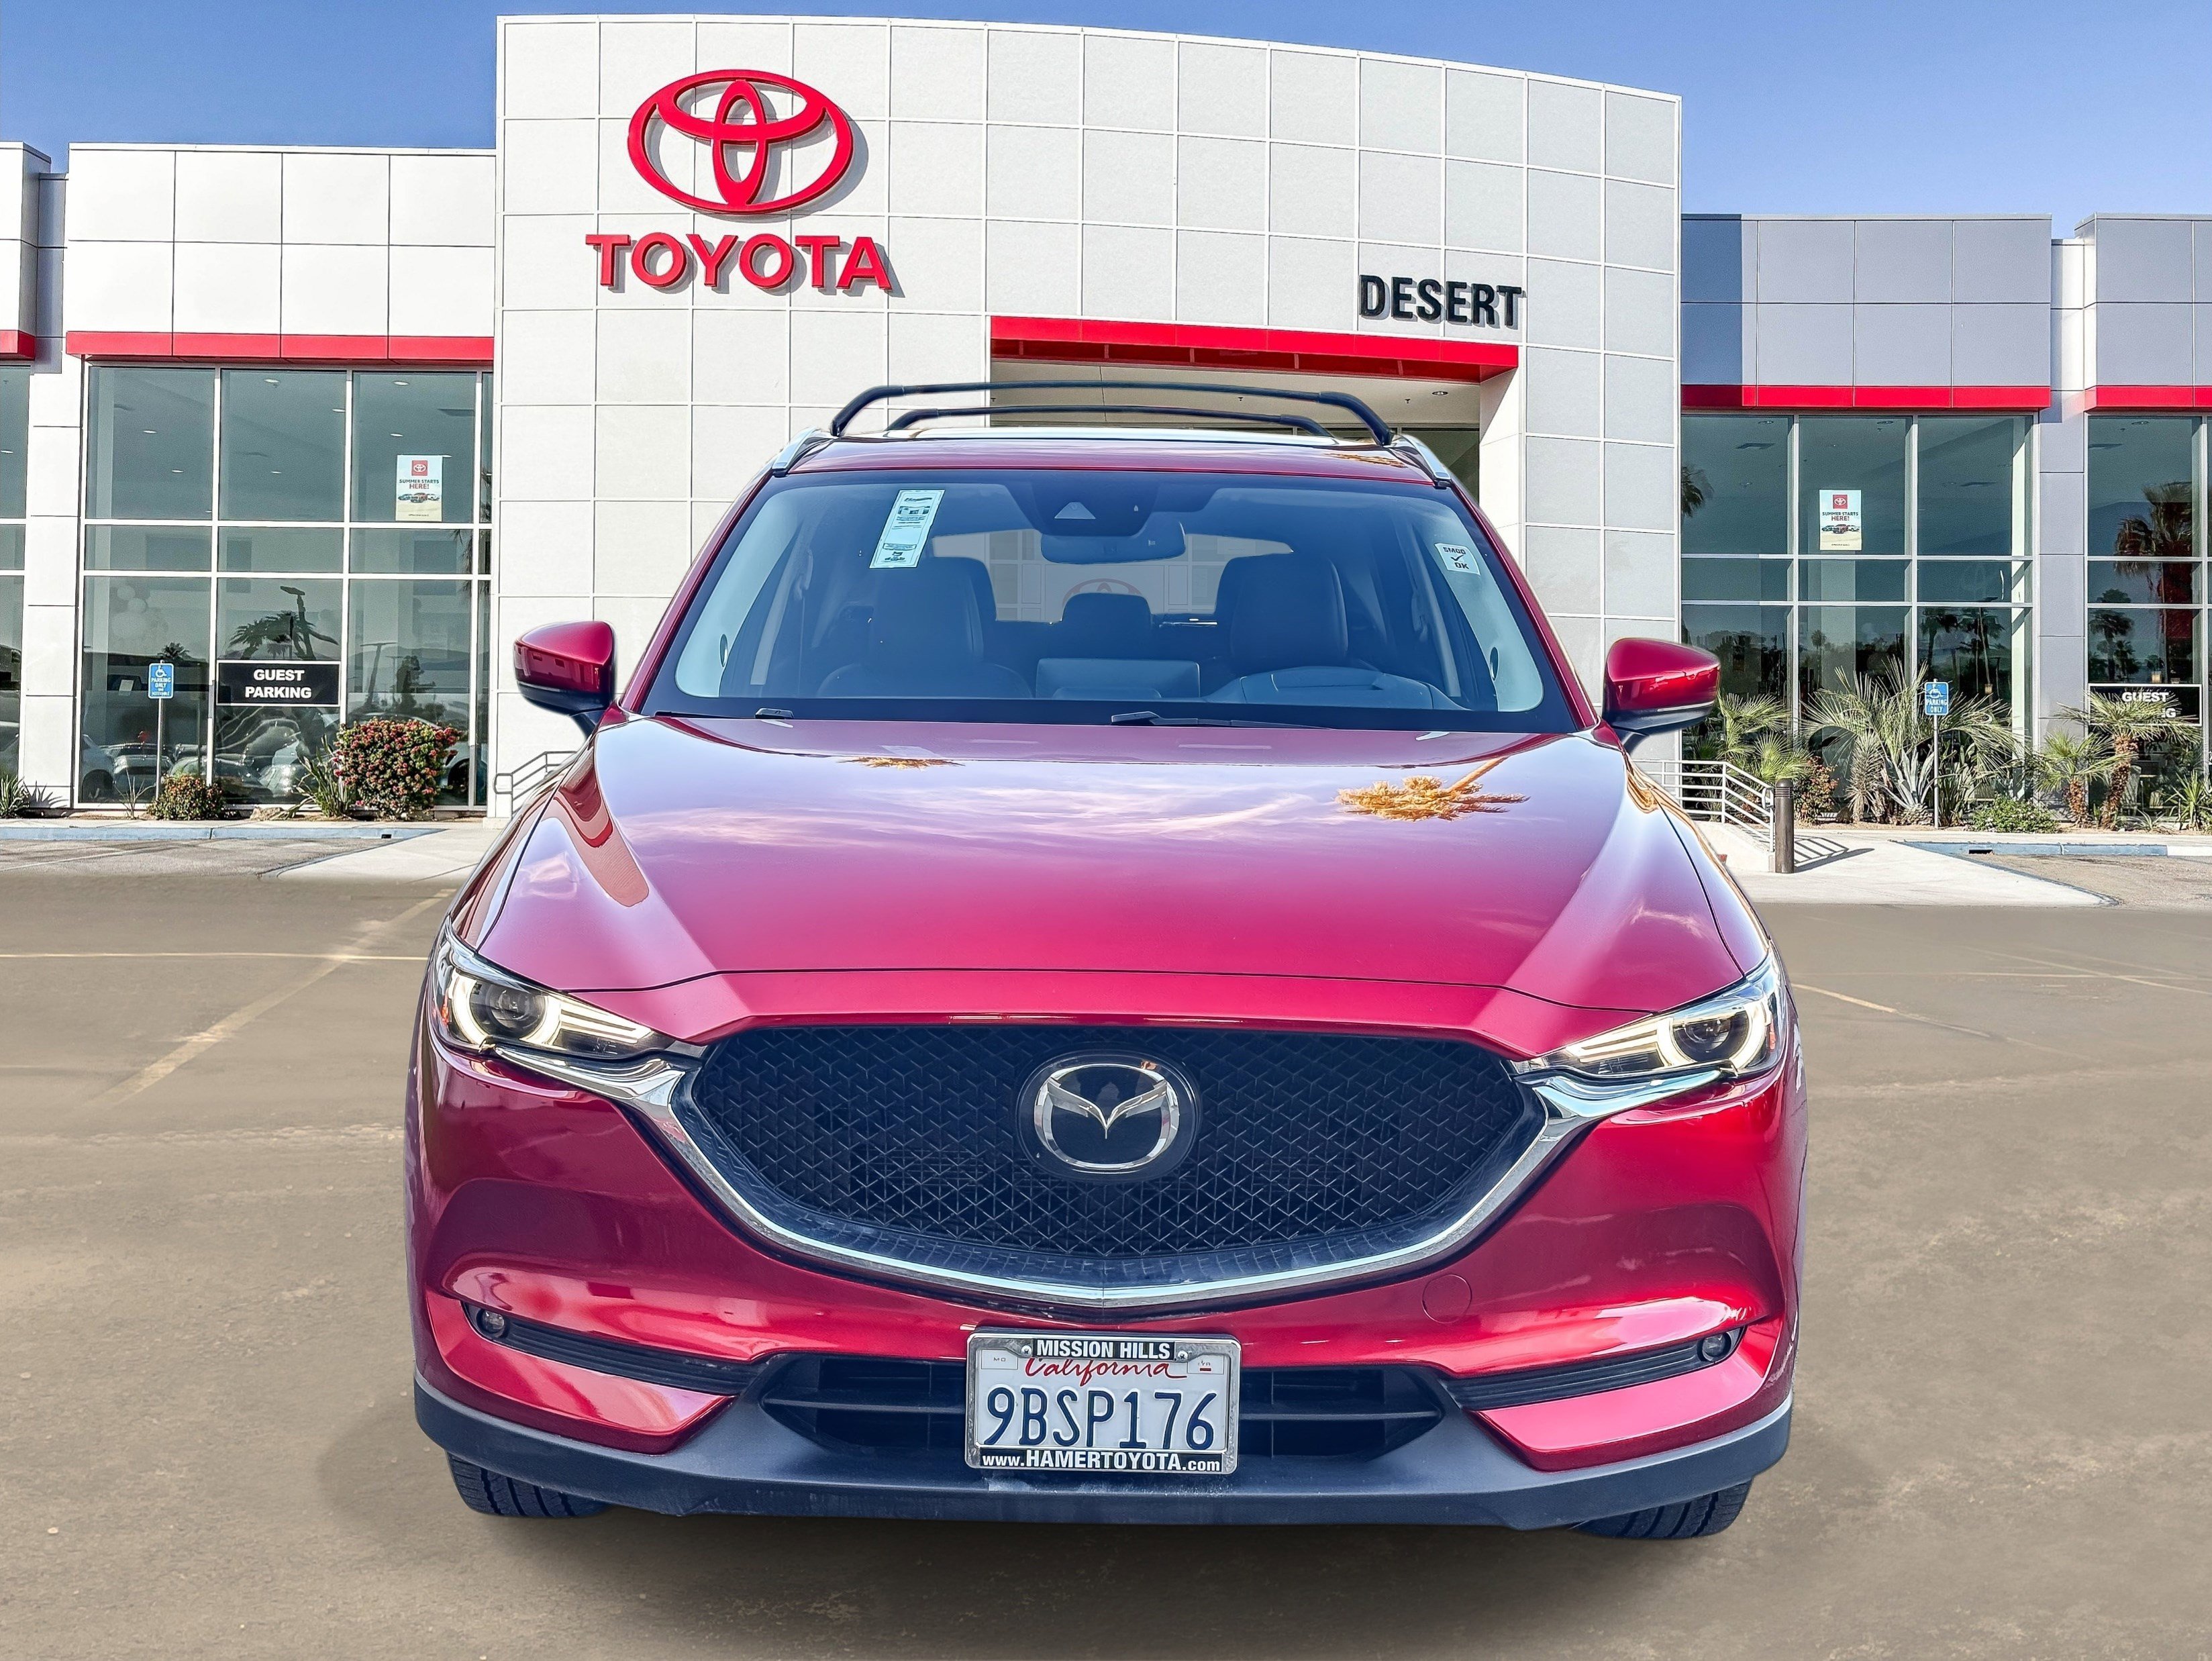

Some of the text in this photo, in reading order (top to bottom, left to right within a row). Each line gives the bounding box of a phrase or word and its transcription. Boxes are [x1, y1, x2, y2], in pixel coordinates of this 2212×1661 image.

[585, 232, 893, 291] TOYOTA
[1359, 274, 1522, 326] DESERT
[1454, 562, 1469, 570] OK
[253, 669, 305, 681] GUEST
[244, 686, 312, 699] PARKING
[2121, 691, 2169, 703] GUEST
[1037, 1340, 1170, 1360] MISSION HILLS
[1024, 1357, 1187, 1387] California
[983, 1387, 1217, 1450] 9BSP176
[983, 1450, 1221, 1472] www.HAMERTOYOTA.com
